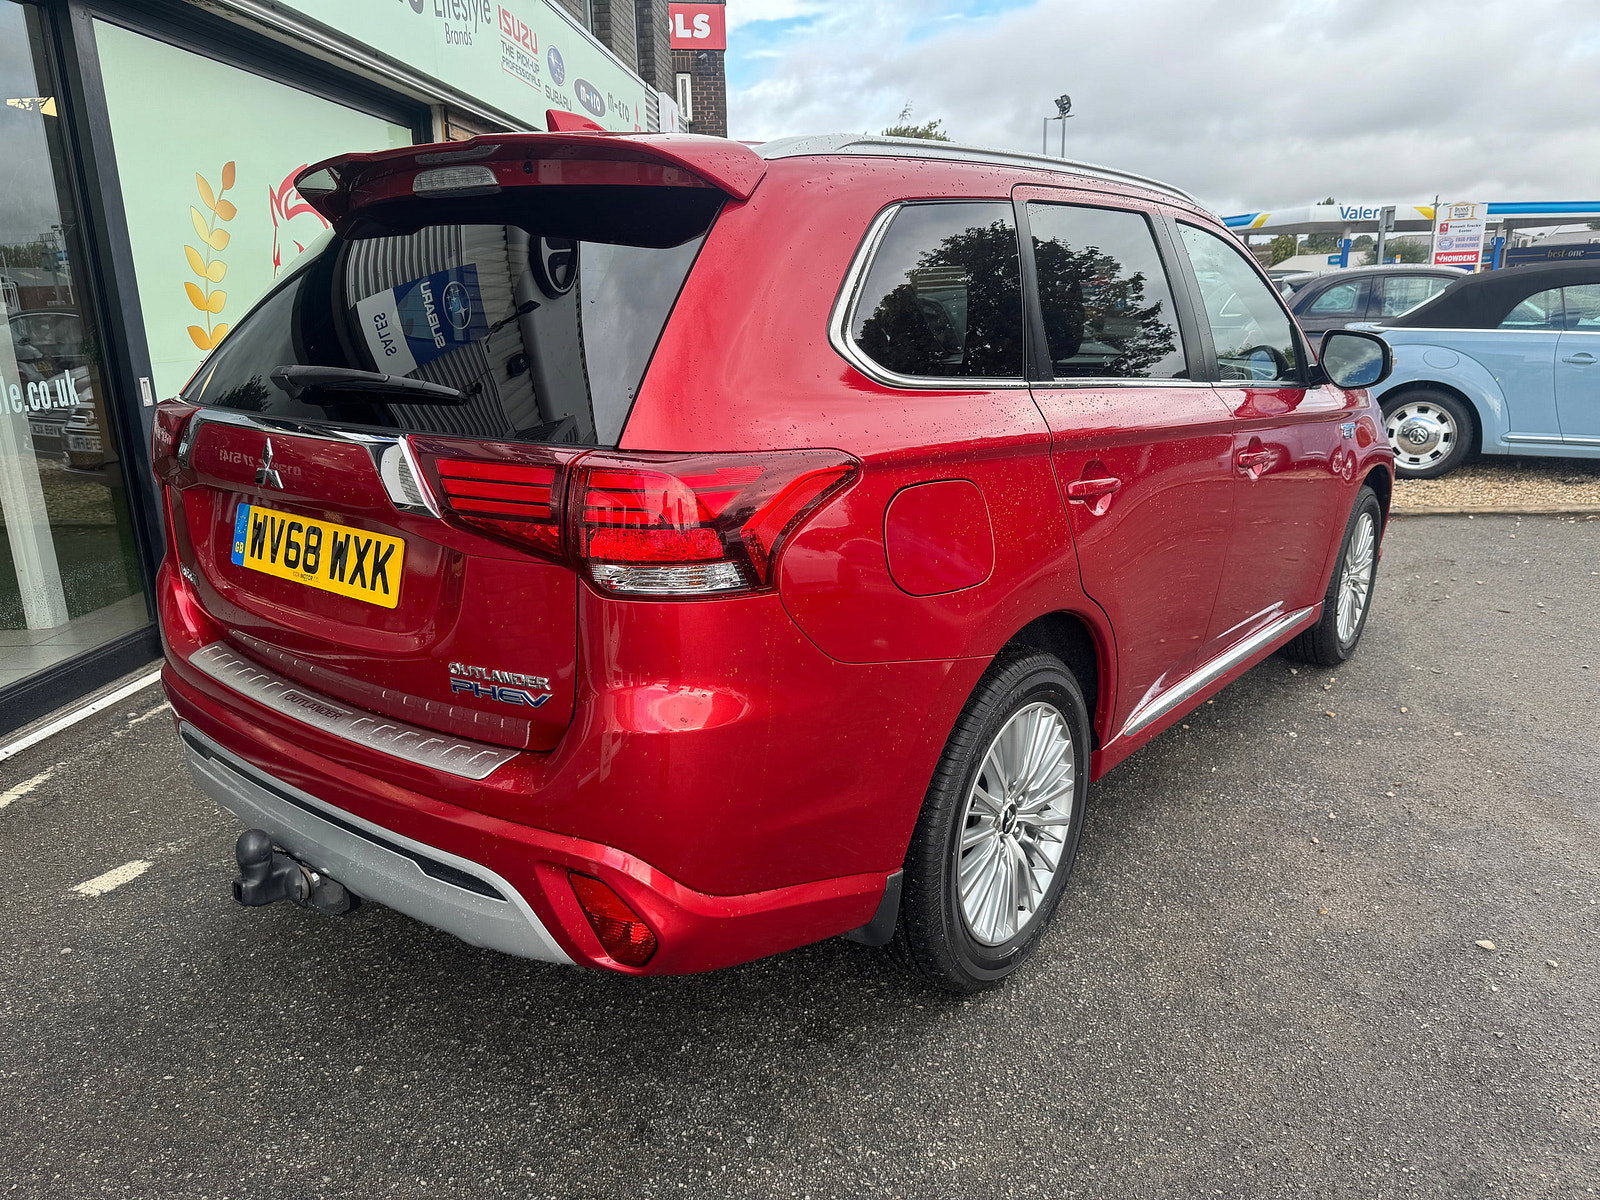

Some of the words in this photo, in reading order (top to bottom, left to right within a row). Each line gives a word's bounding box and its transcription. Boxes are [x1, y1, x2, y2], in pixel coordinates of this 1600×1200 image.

[445, 22, 473, 46] Brands
[497, 4, 538, 55] ISUZU
[669, 13, 711, 39] LS
[501, 40, 514, 60] THE
[516, 50, 540, 75] PICK-UP
[501, 56, 541, 87] PROFESSIONALS
[544, 84, 572, 111] SUBARU
[1340, 206, 1381, 220] Valer
[1442, 254, 1477, 262] HOWDENS
[0, 369, 80, 414] le.co.uk
[235, 541, 244, 554] GB
[250, 513, 323, 575] WV68
[329, 530, 395, 595] WXK
[448, 661, 551, 691] OUTLANDER
[284, 693, 342, 720] OUTLANDER
[450, 677, 554, 708] PHEV
